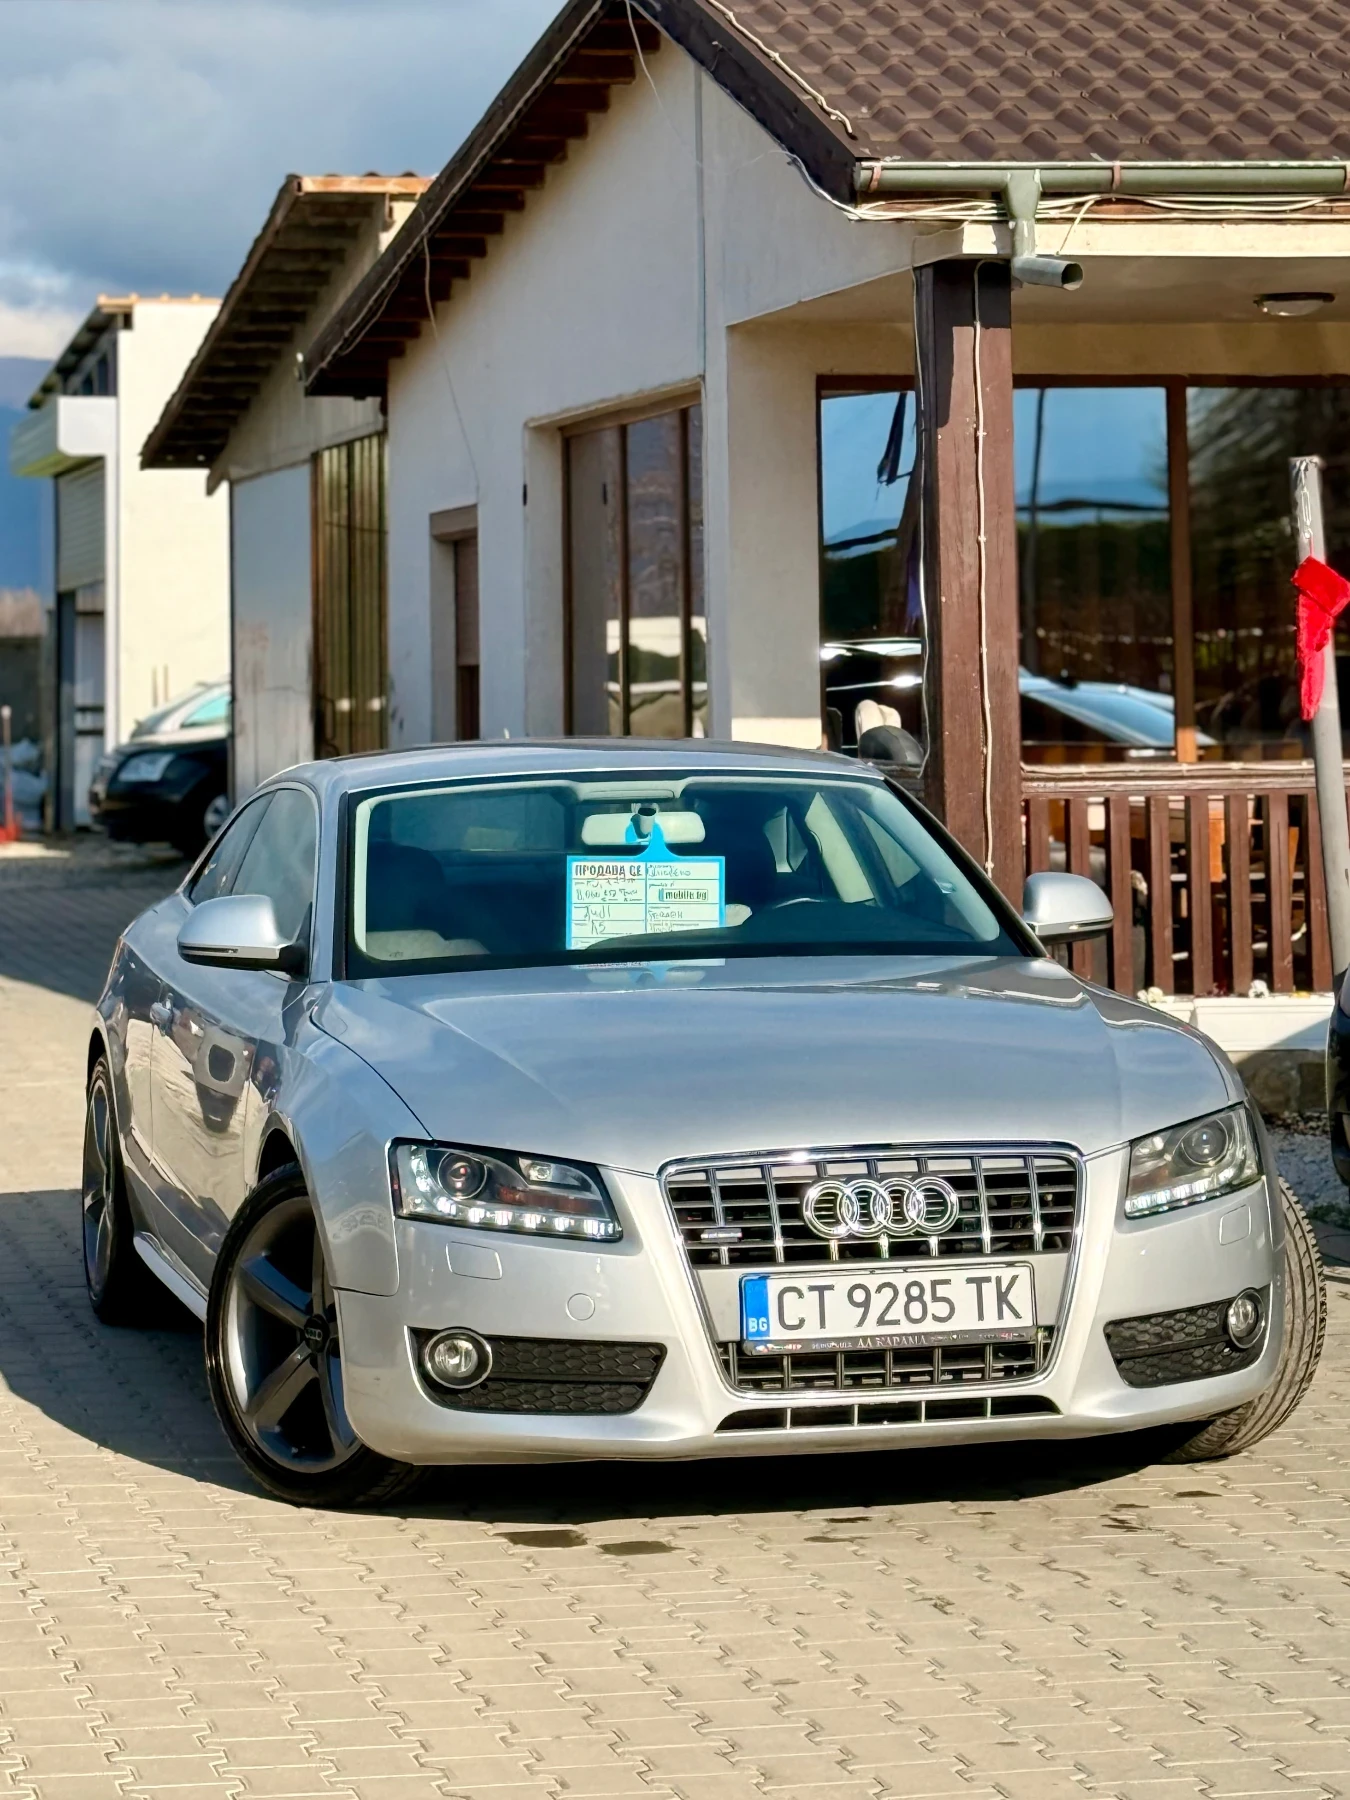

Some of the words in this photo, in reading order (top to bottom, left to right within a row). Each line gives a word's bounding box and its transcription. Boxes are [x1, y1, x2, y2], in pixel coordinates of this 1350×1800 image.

[575, 865, 625, 877] ПРОДАВА
[629, 865, 643, 877] СЕ
[777, 1284, 836, 1331] CT
[847, 1279, 956, 1329] 9285
[965, 1274, 1023, 1322] TK
[748, 1316, 768, 1333] BG
